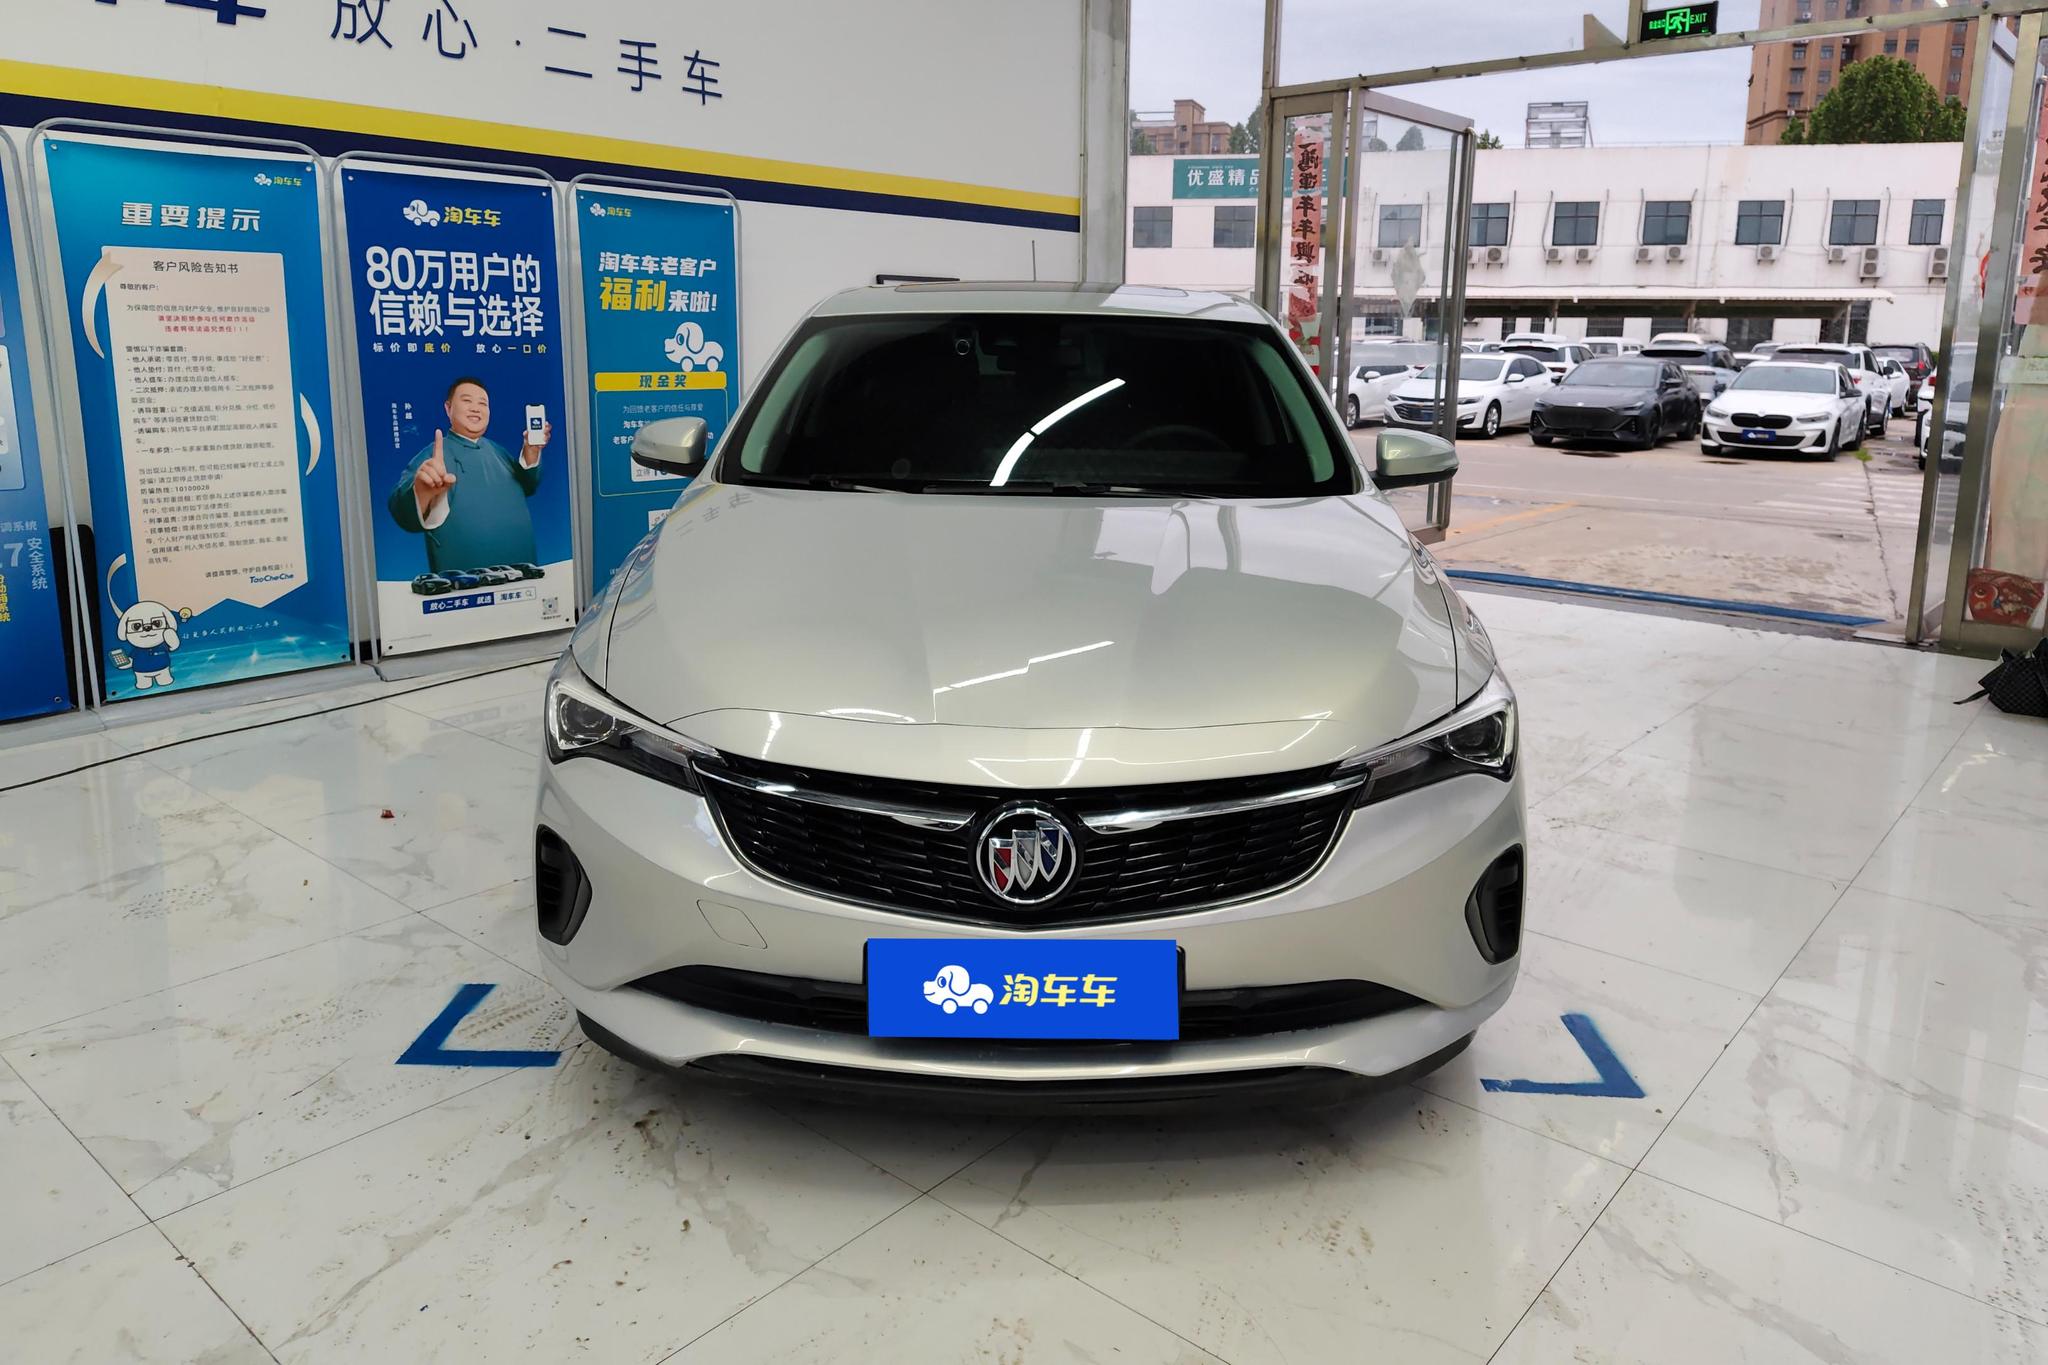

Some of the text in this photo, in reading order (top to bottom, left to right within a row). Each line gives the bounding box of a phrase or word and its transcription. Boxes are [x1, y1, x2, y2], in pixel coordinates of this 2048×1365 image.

[1690, 13, 1707, 24] EXIT
[121, 202, 260, 232] 重要提示
[443, 207, 501, 227] 淘车车
[606, 206, 632, 217] 淘车车
[152, 261, 239, 274] 客户风险告知书
[366, 246, 541, 294] 80万用户的
[598, 251, 717, 277] 淘车车老客户
[369, 290, 544, 337] 信赖与选择
[373, 342, 547, 354] 标价即底价 放心一口价
[639, 374, 688, 388] 现金奖
[27, 537, 48, 590] 安全系统
[250, 573, 294, 583] TaoCheChe
[430, 599, 469, 611] 放心二手车
[1000, 973, 1118, 1008] 淘车车
